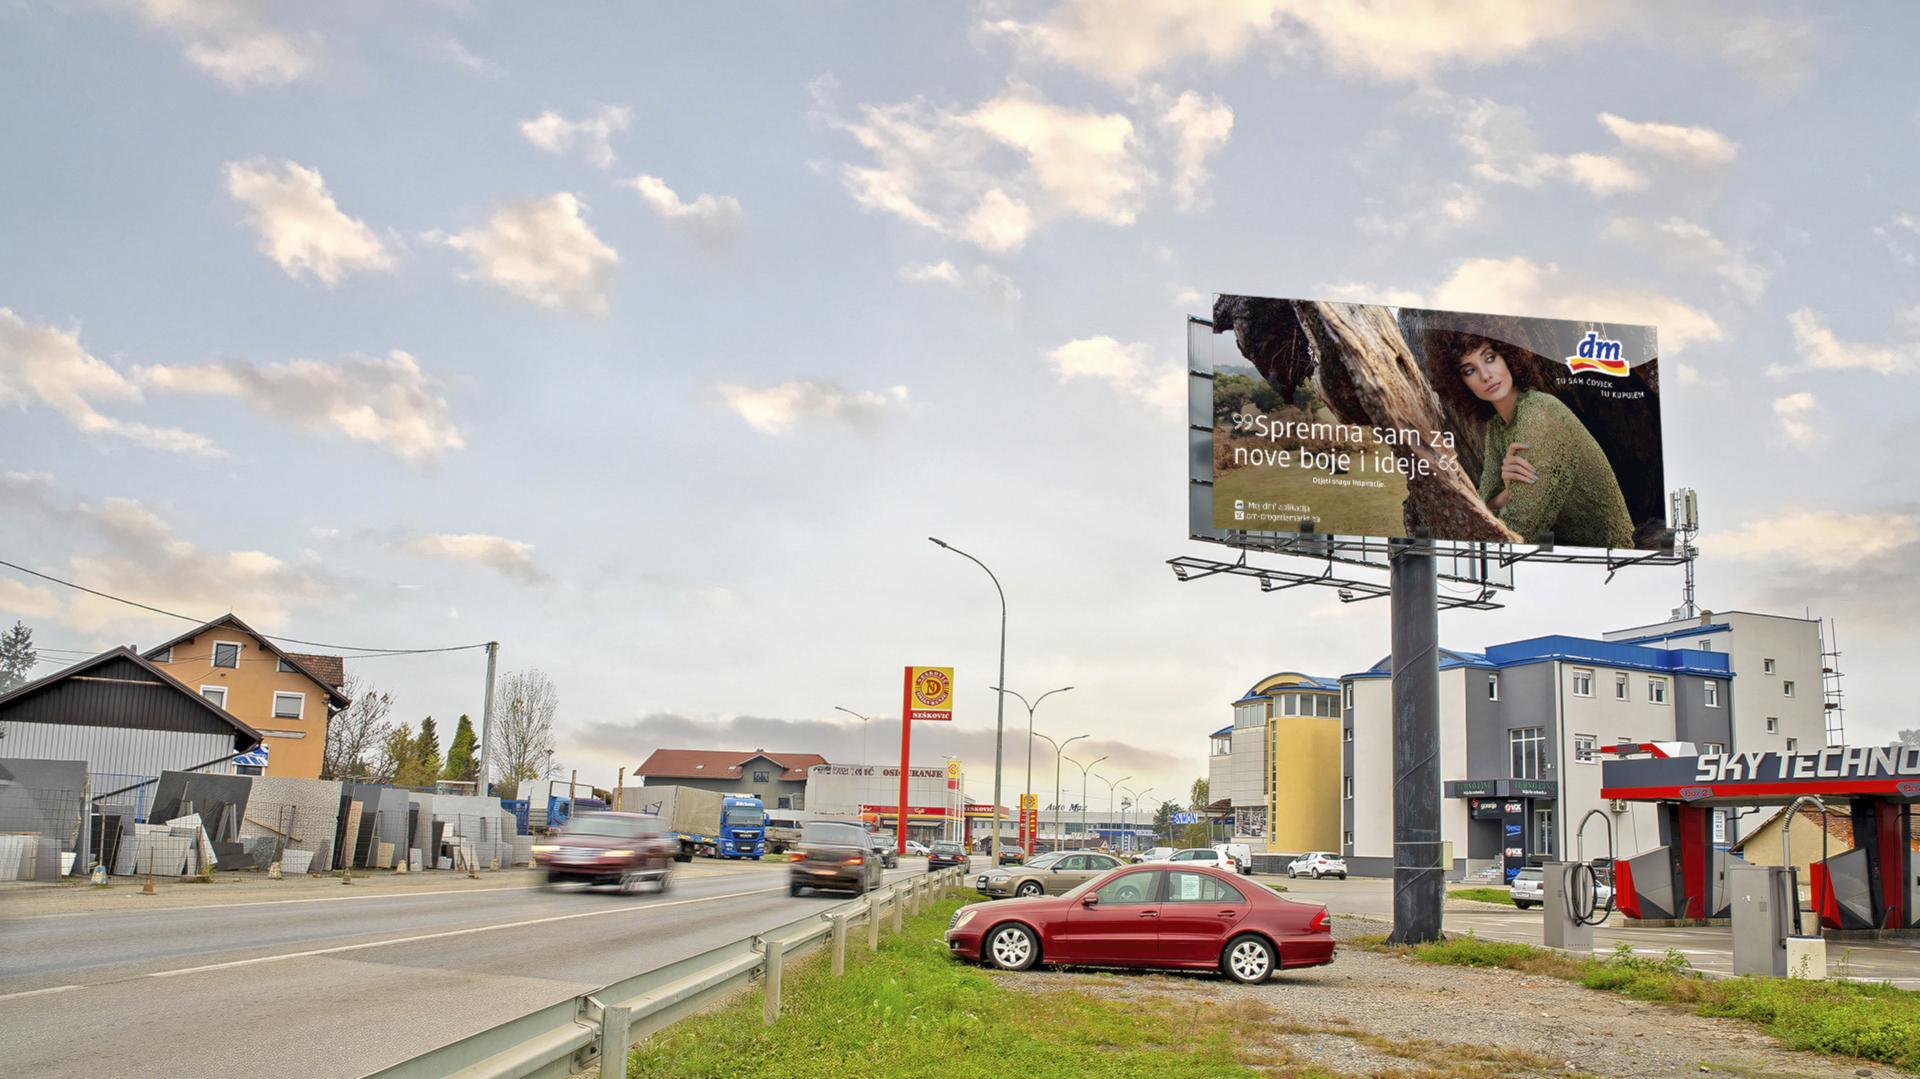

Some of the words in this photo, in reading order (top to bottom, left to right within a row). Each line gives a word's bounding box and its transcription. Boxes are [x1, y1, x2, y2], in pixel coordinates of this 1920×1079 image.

[1578, 332, 1621, 360] dm
[1372, 426, 1421, 446] sam
[1430, 430, 1455, 449] za
[1234, 447, 1291, 468] nove
[1300, 446, 1350, 475] boje
[1360, 450, 1365, 473] i
[1695, 751, 1766, 782] SKY
